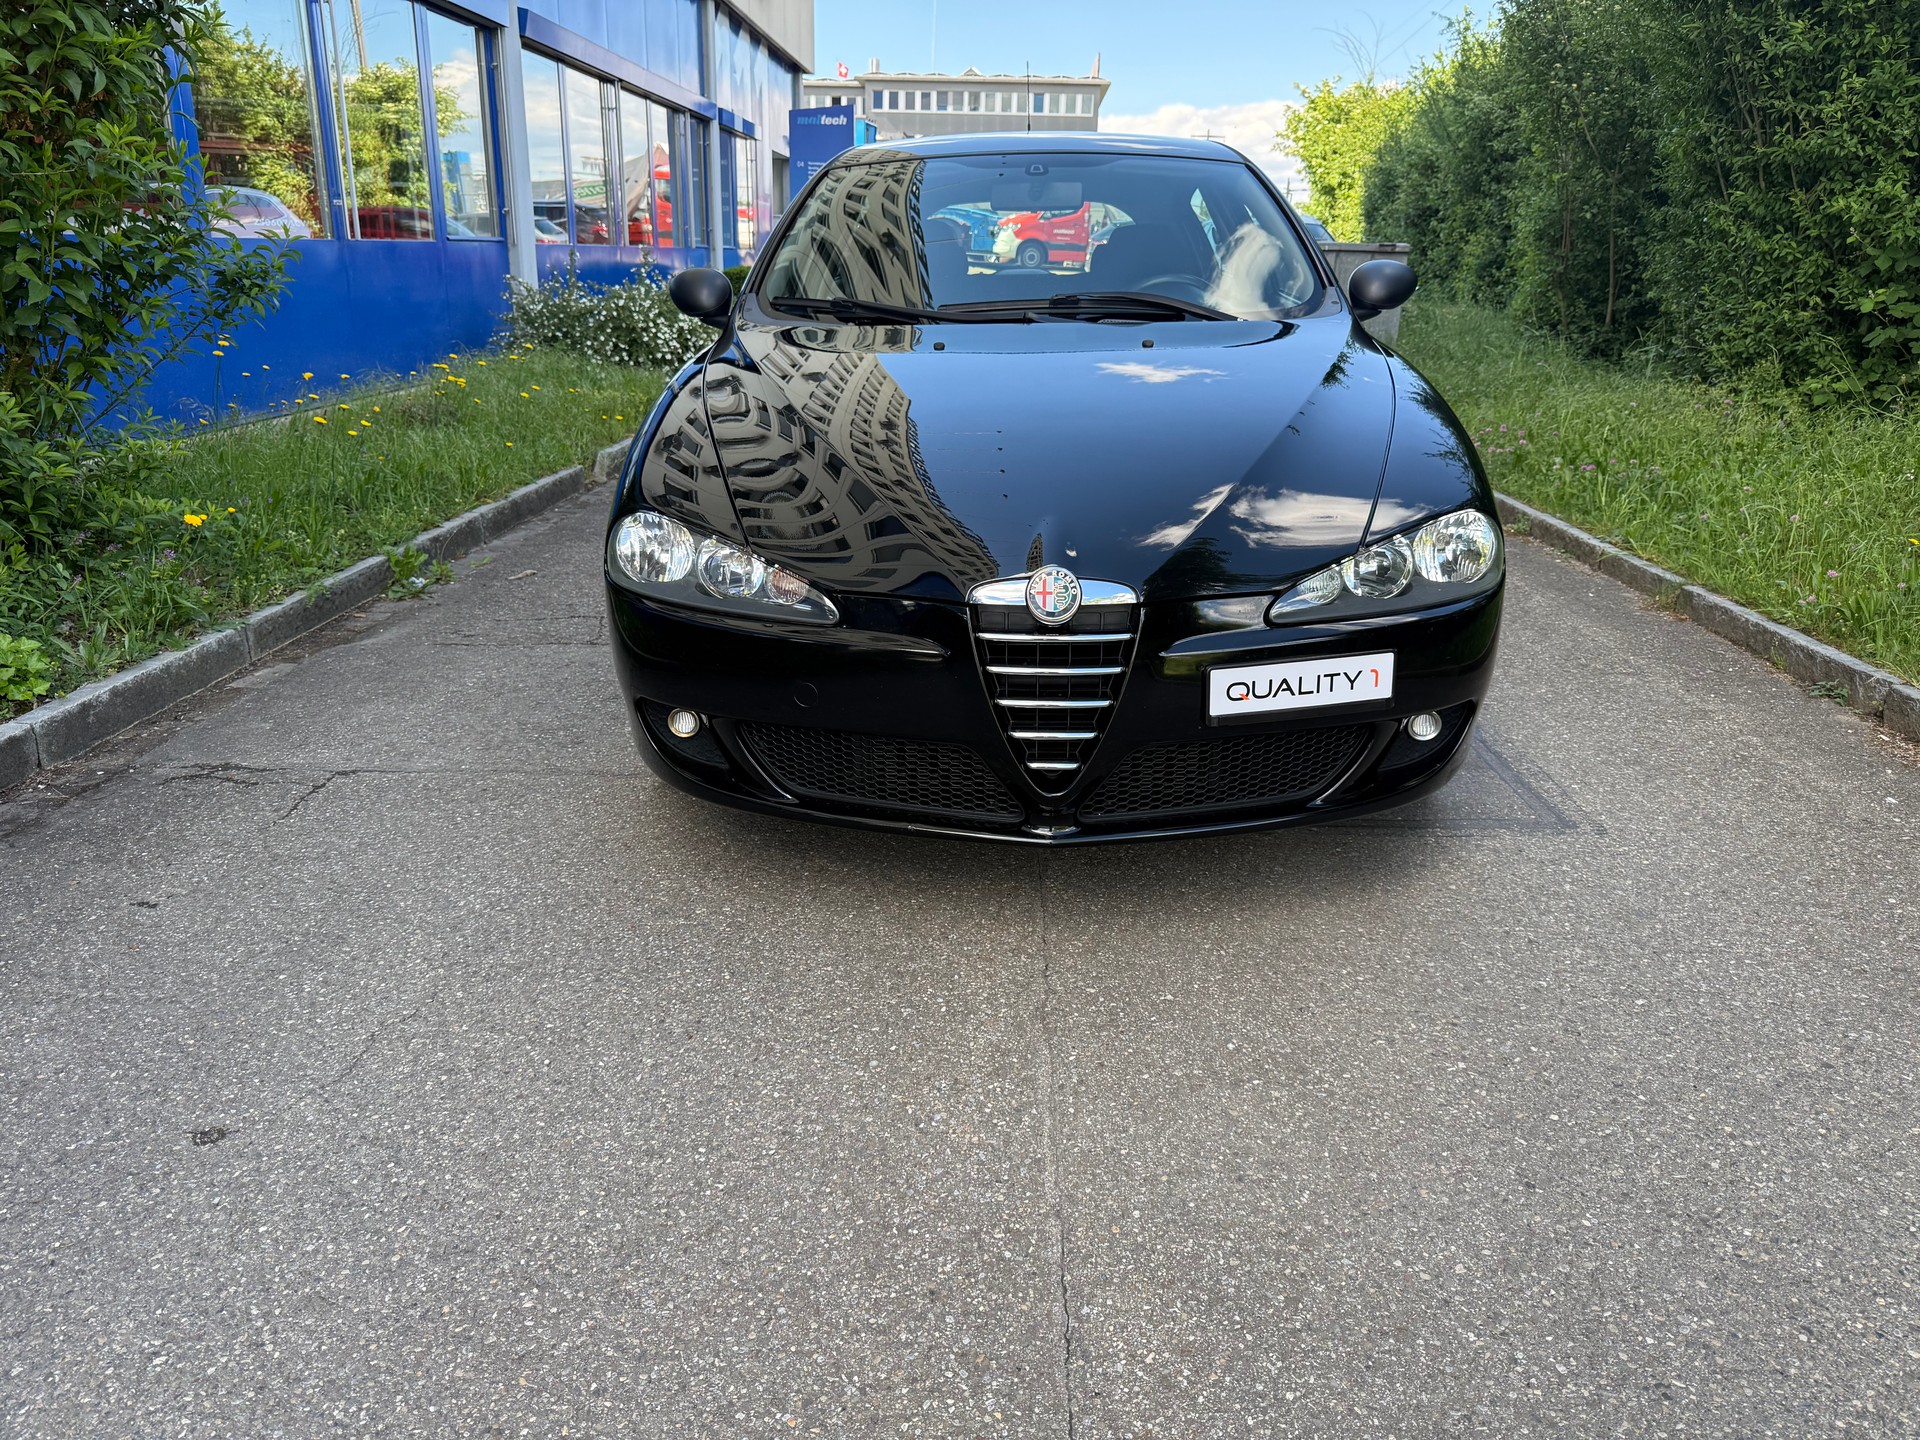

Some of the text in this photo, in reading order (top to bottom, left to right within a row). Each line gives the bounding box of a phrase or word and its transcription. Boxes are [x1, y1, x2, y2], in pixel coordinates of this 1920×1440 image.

[1051, 570, 1077, 595] ROMEO
[1226, 668, 1380, 702] QUALITY 1
